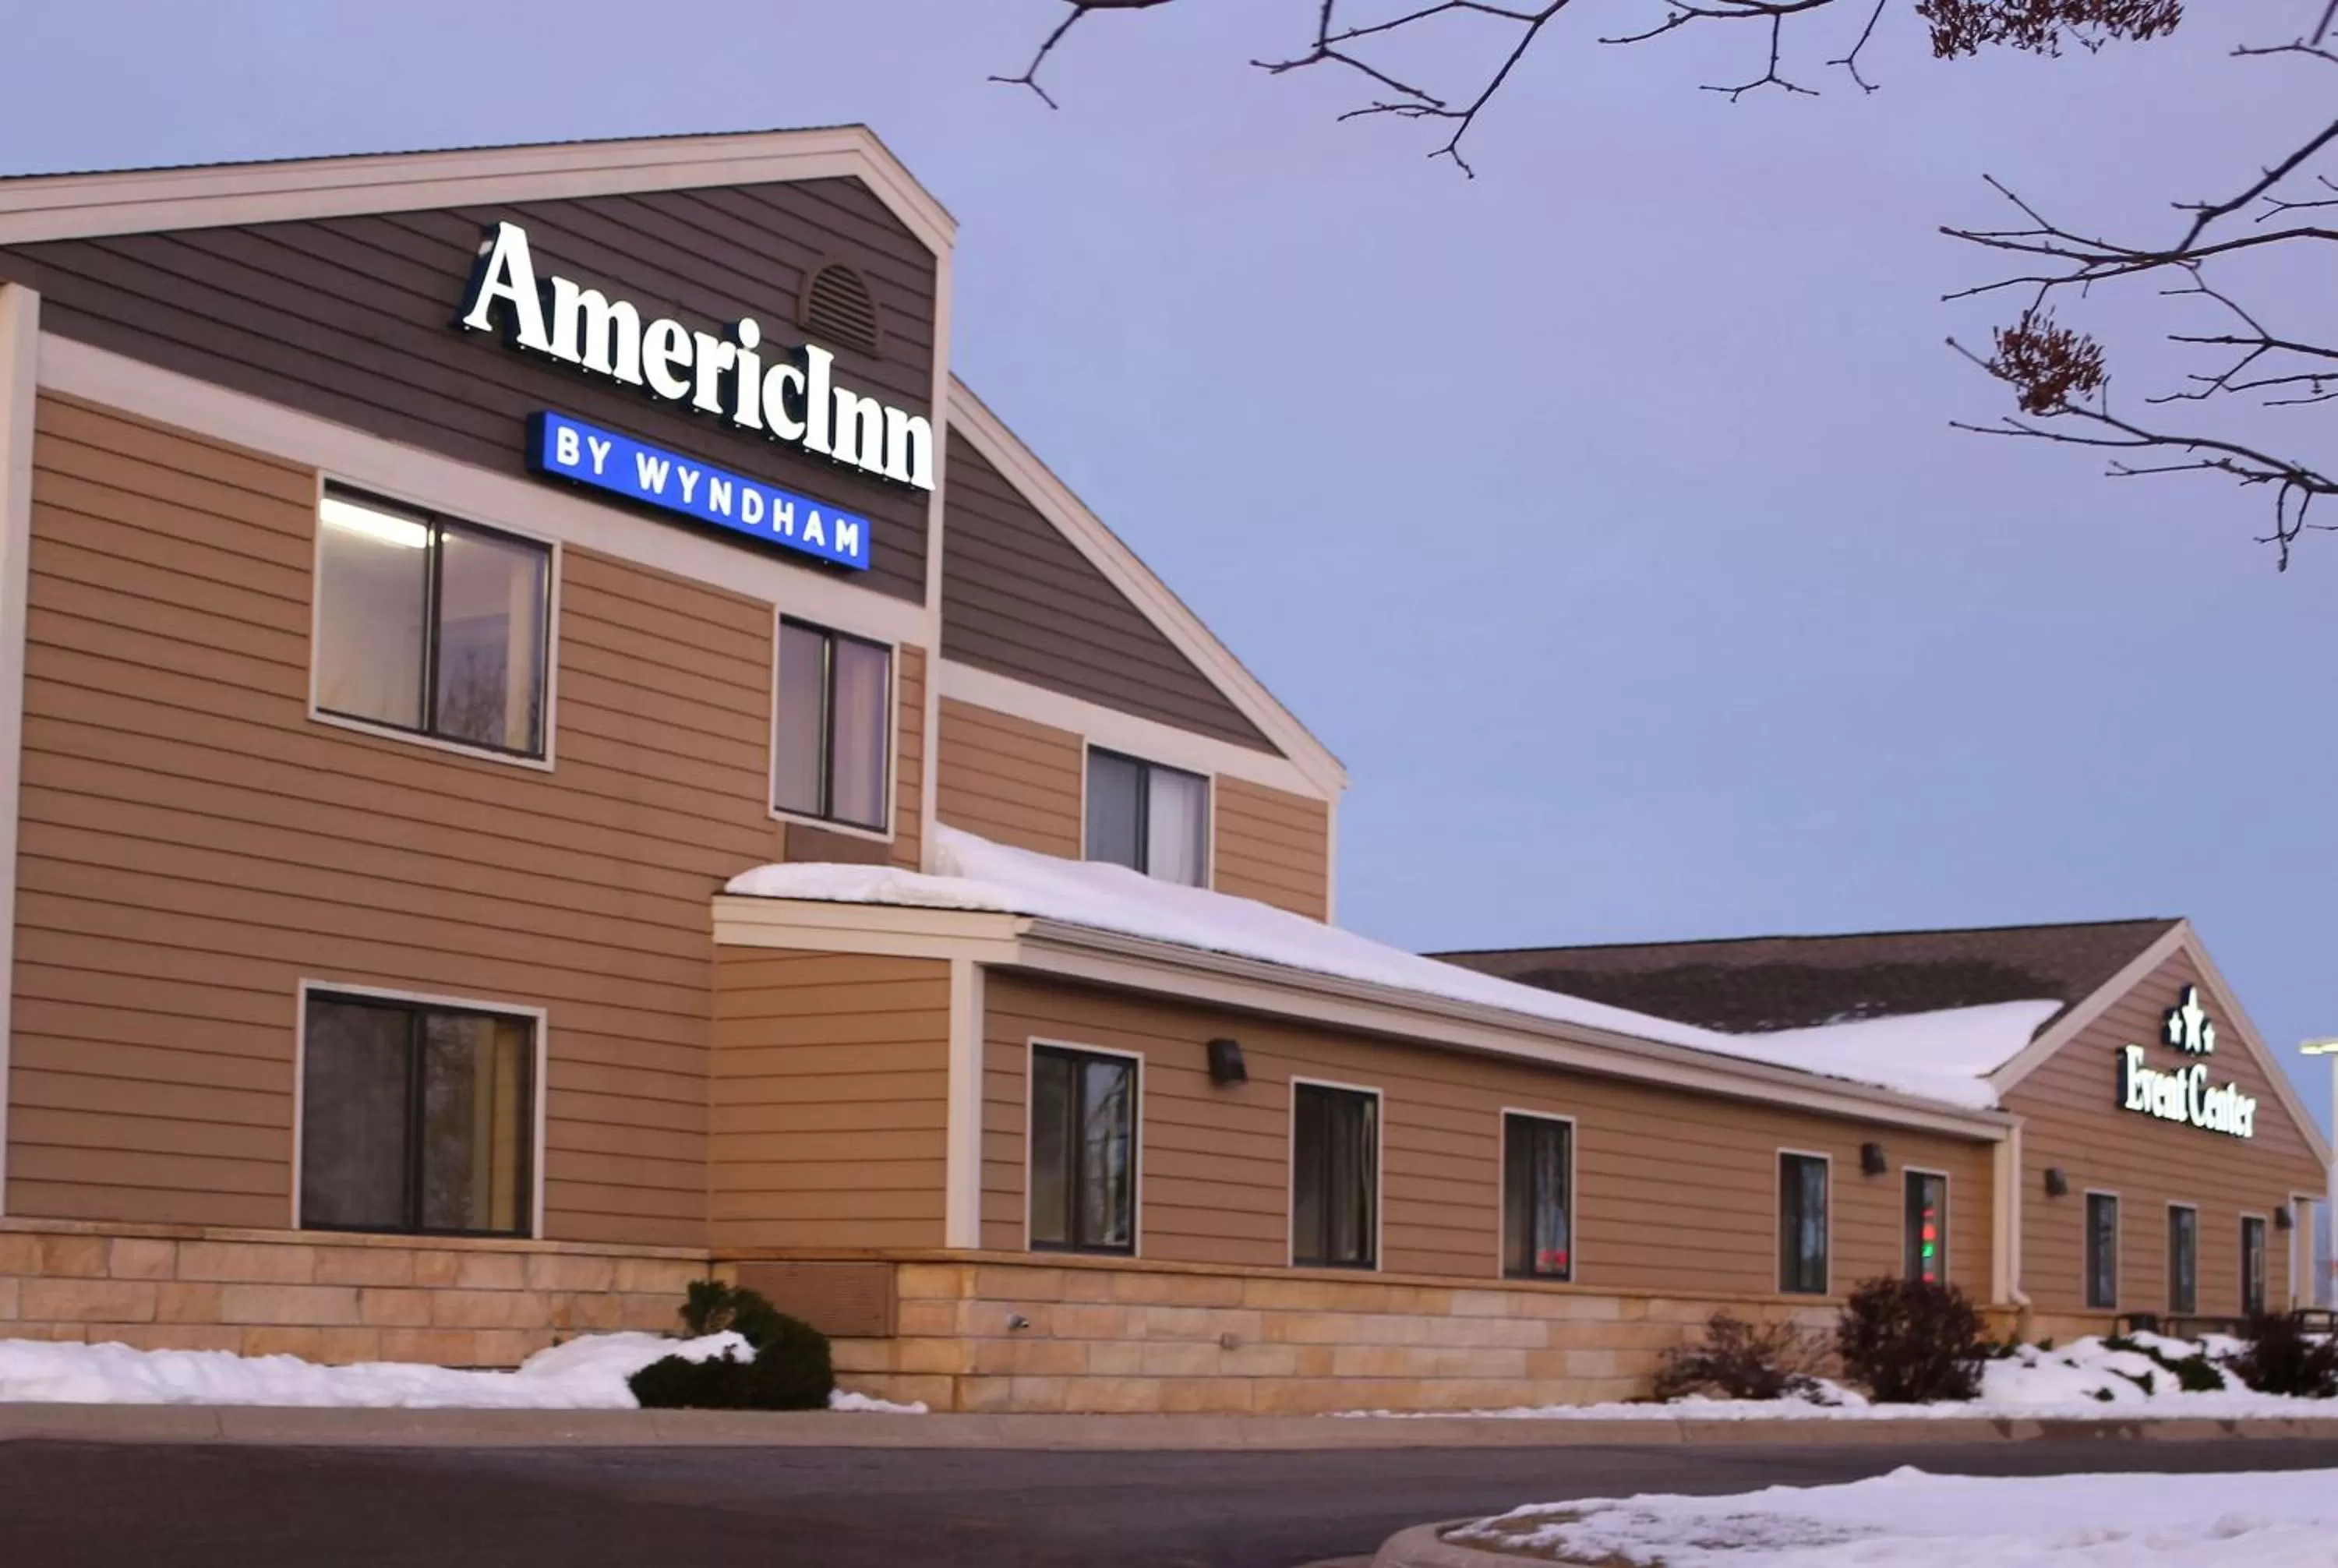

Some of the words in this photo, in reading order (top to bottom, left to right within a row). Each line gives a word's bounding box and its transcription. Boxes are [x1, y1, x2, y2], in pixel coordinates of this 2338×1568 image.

[463, 221, 935, 491] AmericInn
[556, 426, 612, 475] BY
[636, 452, 858, 557] WYNDHAM
[2125, 1044, 2188, 1121] Event
[2189, 1063, 2256, 1138] Center
